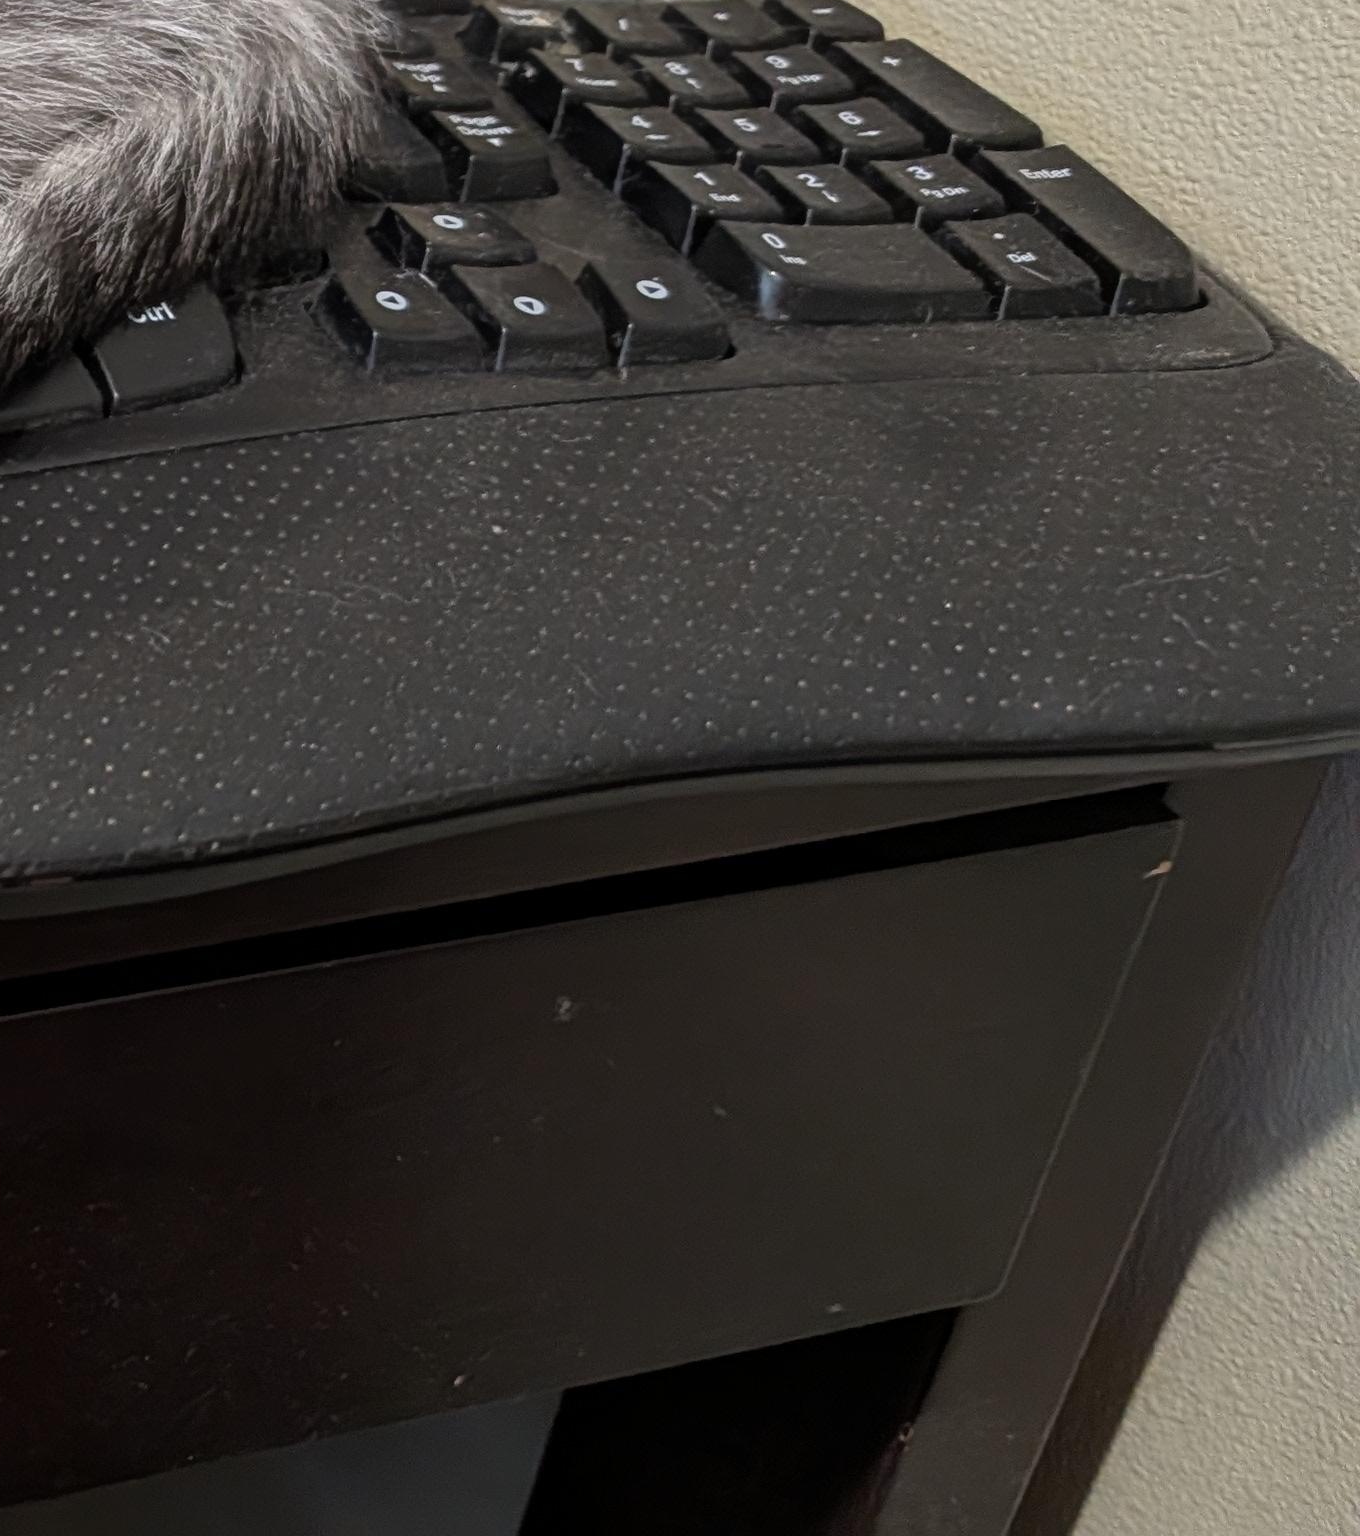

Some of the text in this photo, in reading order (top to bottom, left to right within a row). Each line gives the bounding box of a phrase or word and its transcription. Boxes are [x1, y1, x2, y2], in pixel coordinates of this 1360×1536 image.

[764, 55, 791, 69] 9
[448, 114, 501, 127] Page
[631, 115, 652, 128] 4
[733, 117, 760, 132] 5
[838, 111, 864, 126] 6
[456, 126, 514, 137] Down
[694, 171, 717, 185] 1
[905, 165, 934, 180] 3
[1019, 166, 1073, 180] Enter
[797, 173, 825, 188] 2
[709, 192, 742, 203] End
[761, 232, 786, 248] 0
[1006, 252, 1039, 265] Del
